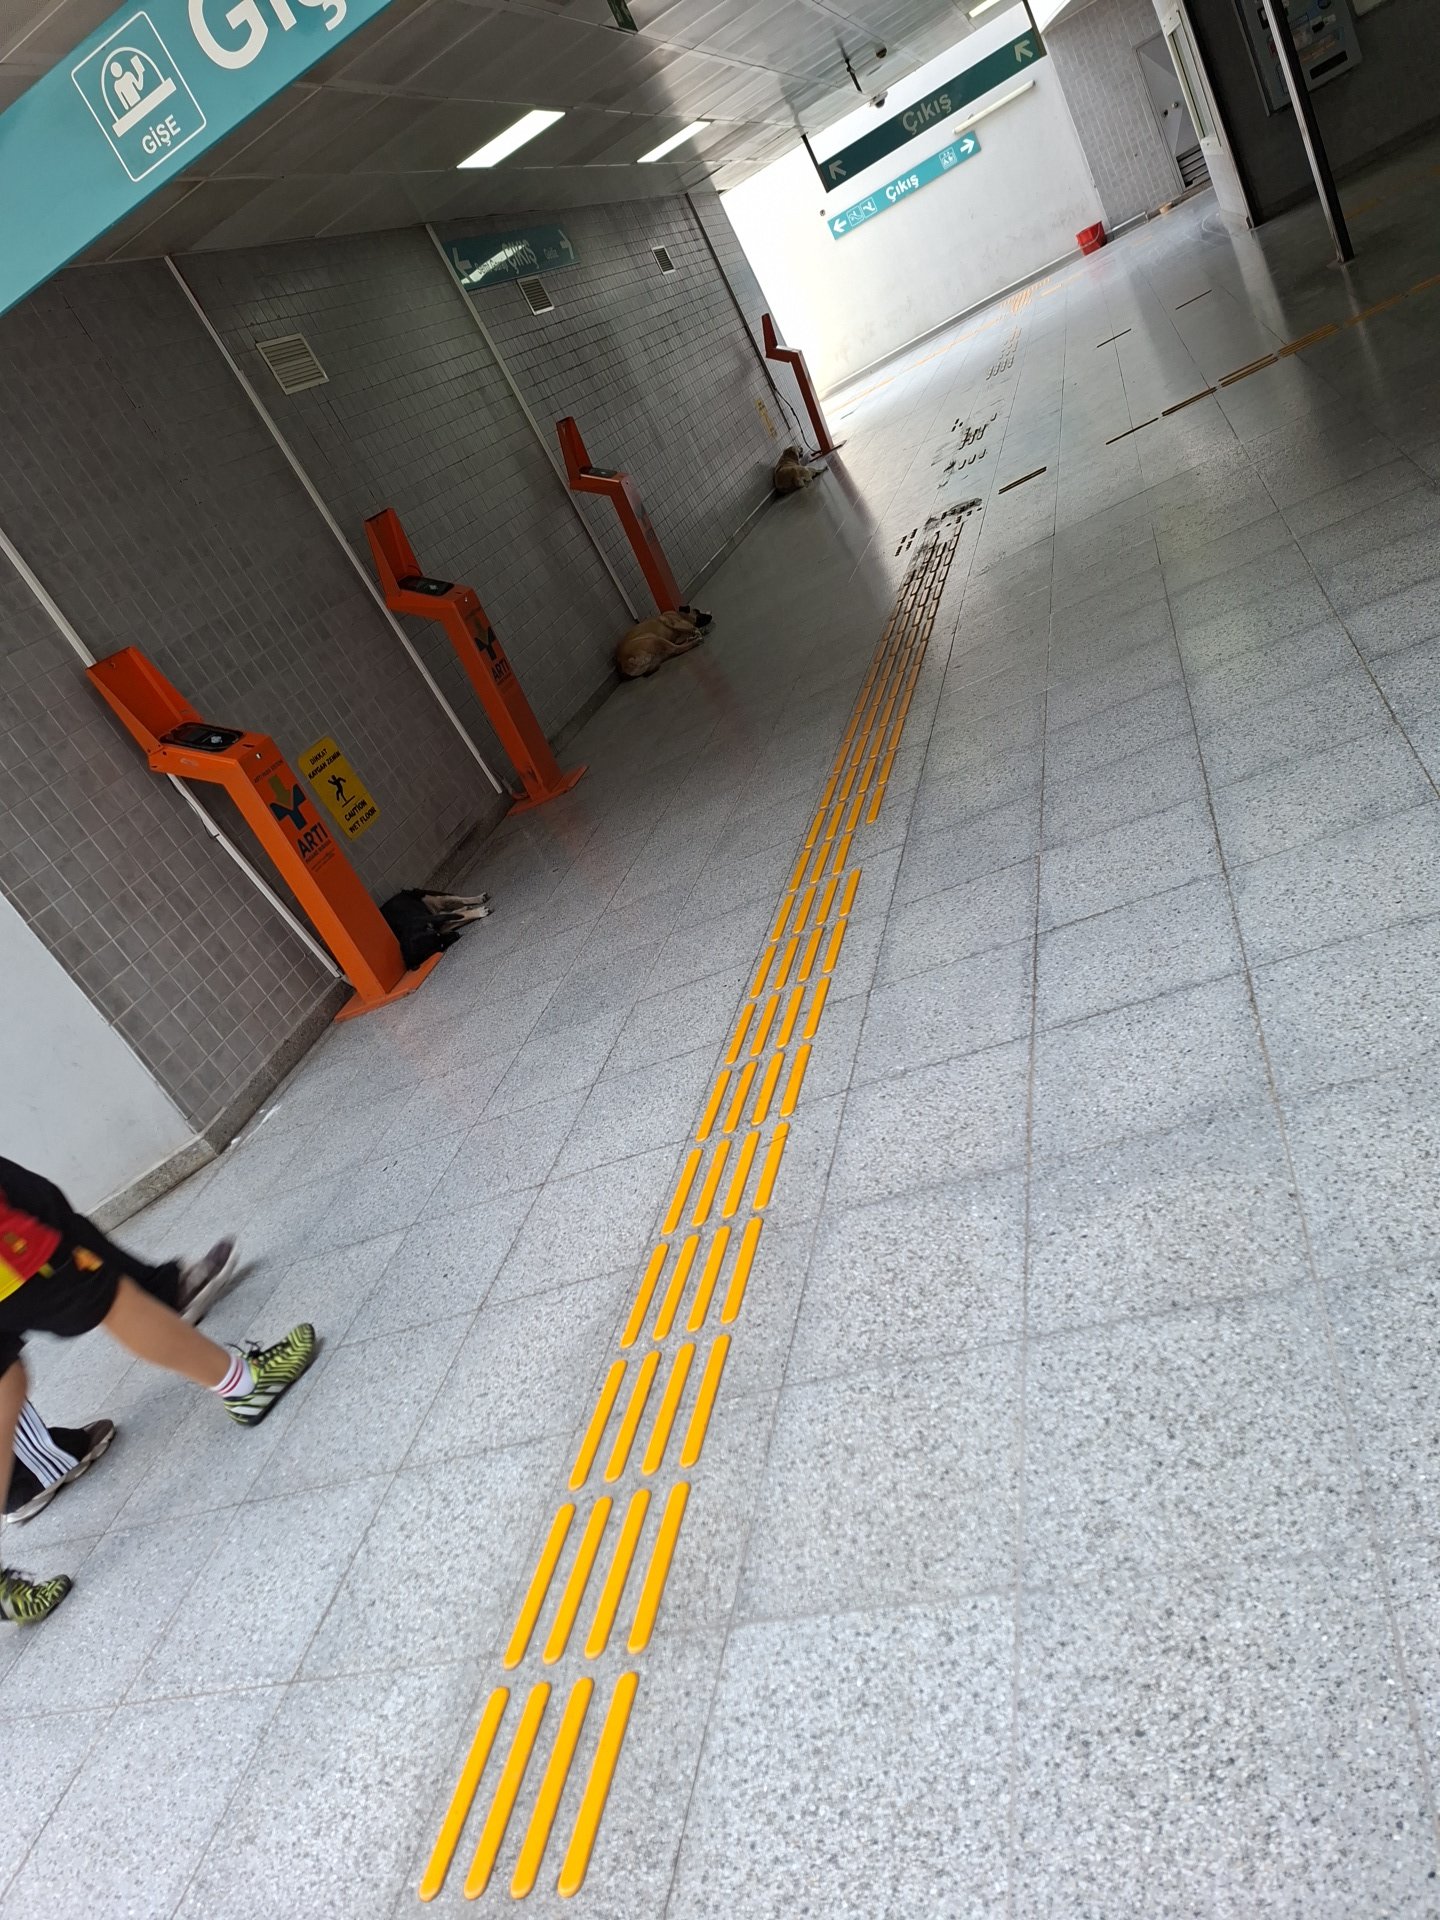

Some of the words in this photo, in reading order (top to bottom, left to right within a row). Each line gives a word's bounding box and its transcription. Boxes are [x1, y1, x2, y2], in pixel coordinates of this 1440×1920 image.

[902, 94, 952, 136] Çıkış
[142, 114, 181, 154] GİŞE
[885, 174, 919, 203] Çıkış
[349, 818, 362, 834] WET
[359, 806, 377, 826] FLOOR
[297, 822, 329, 859] ARTI
